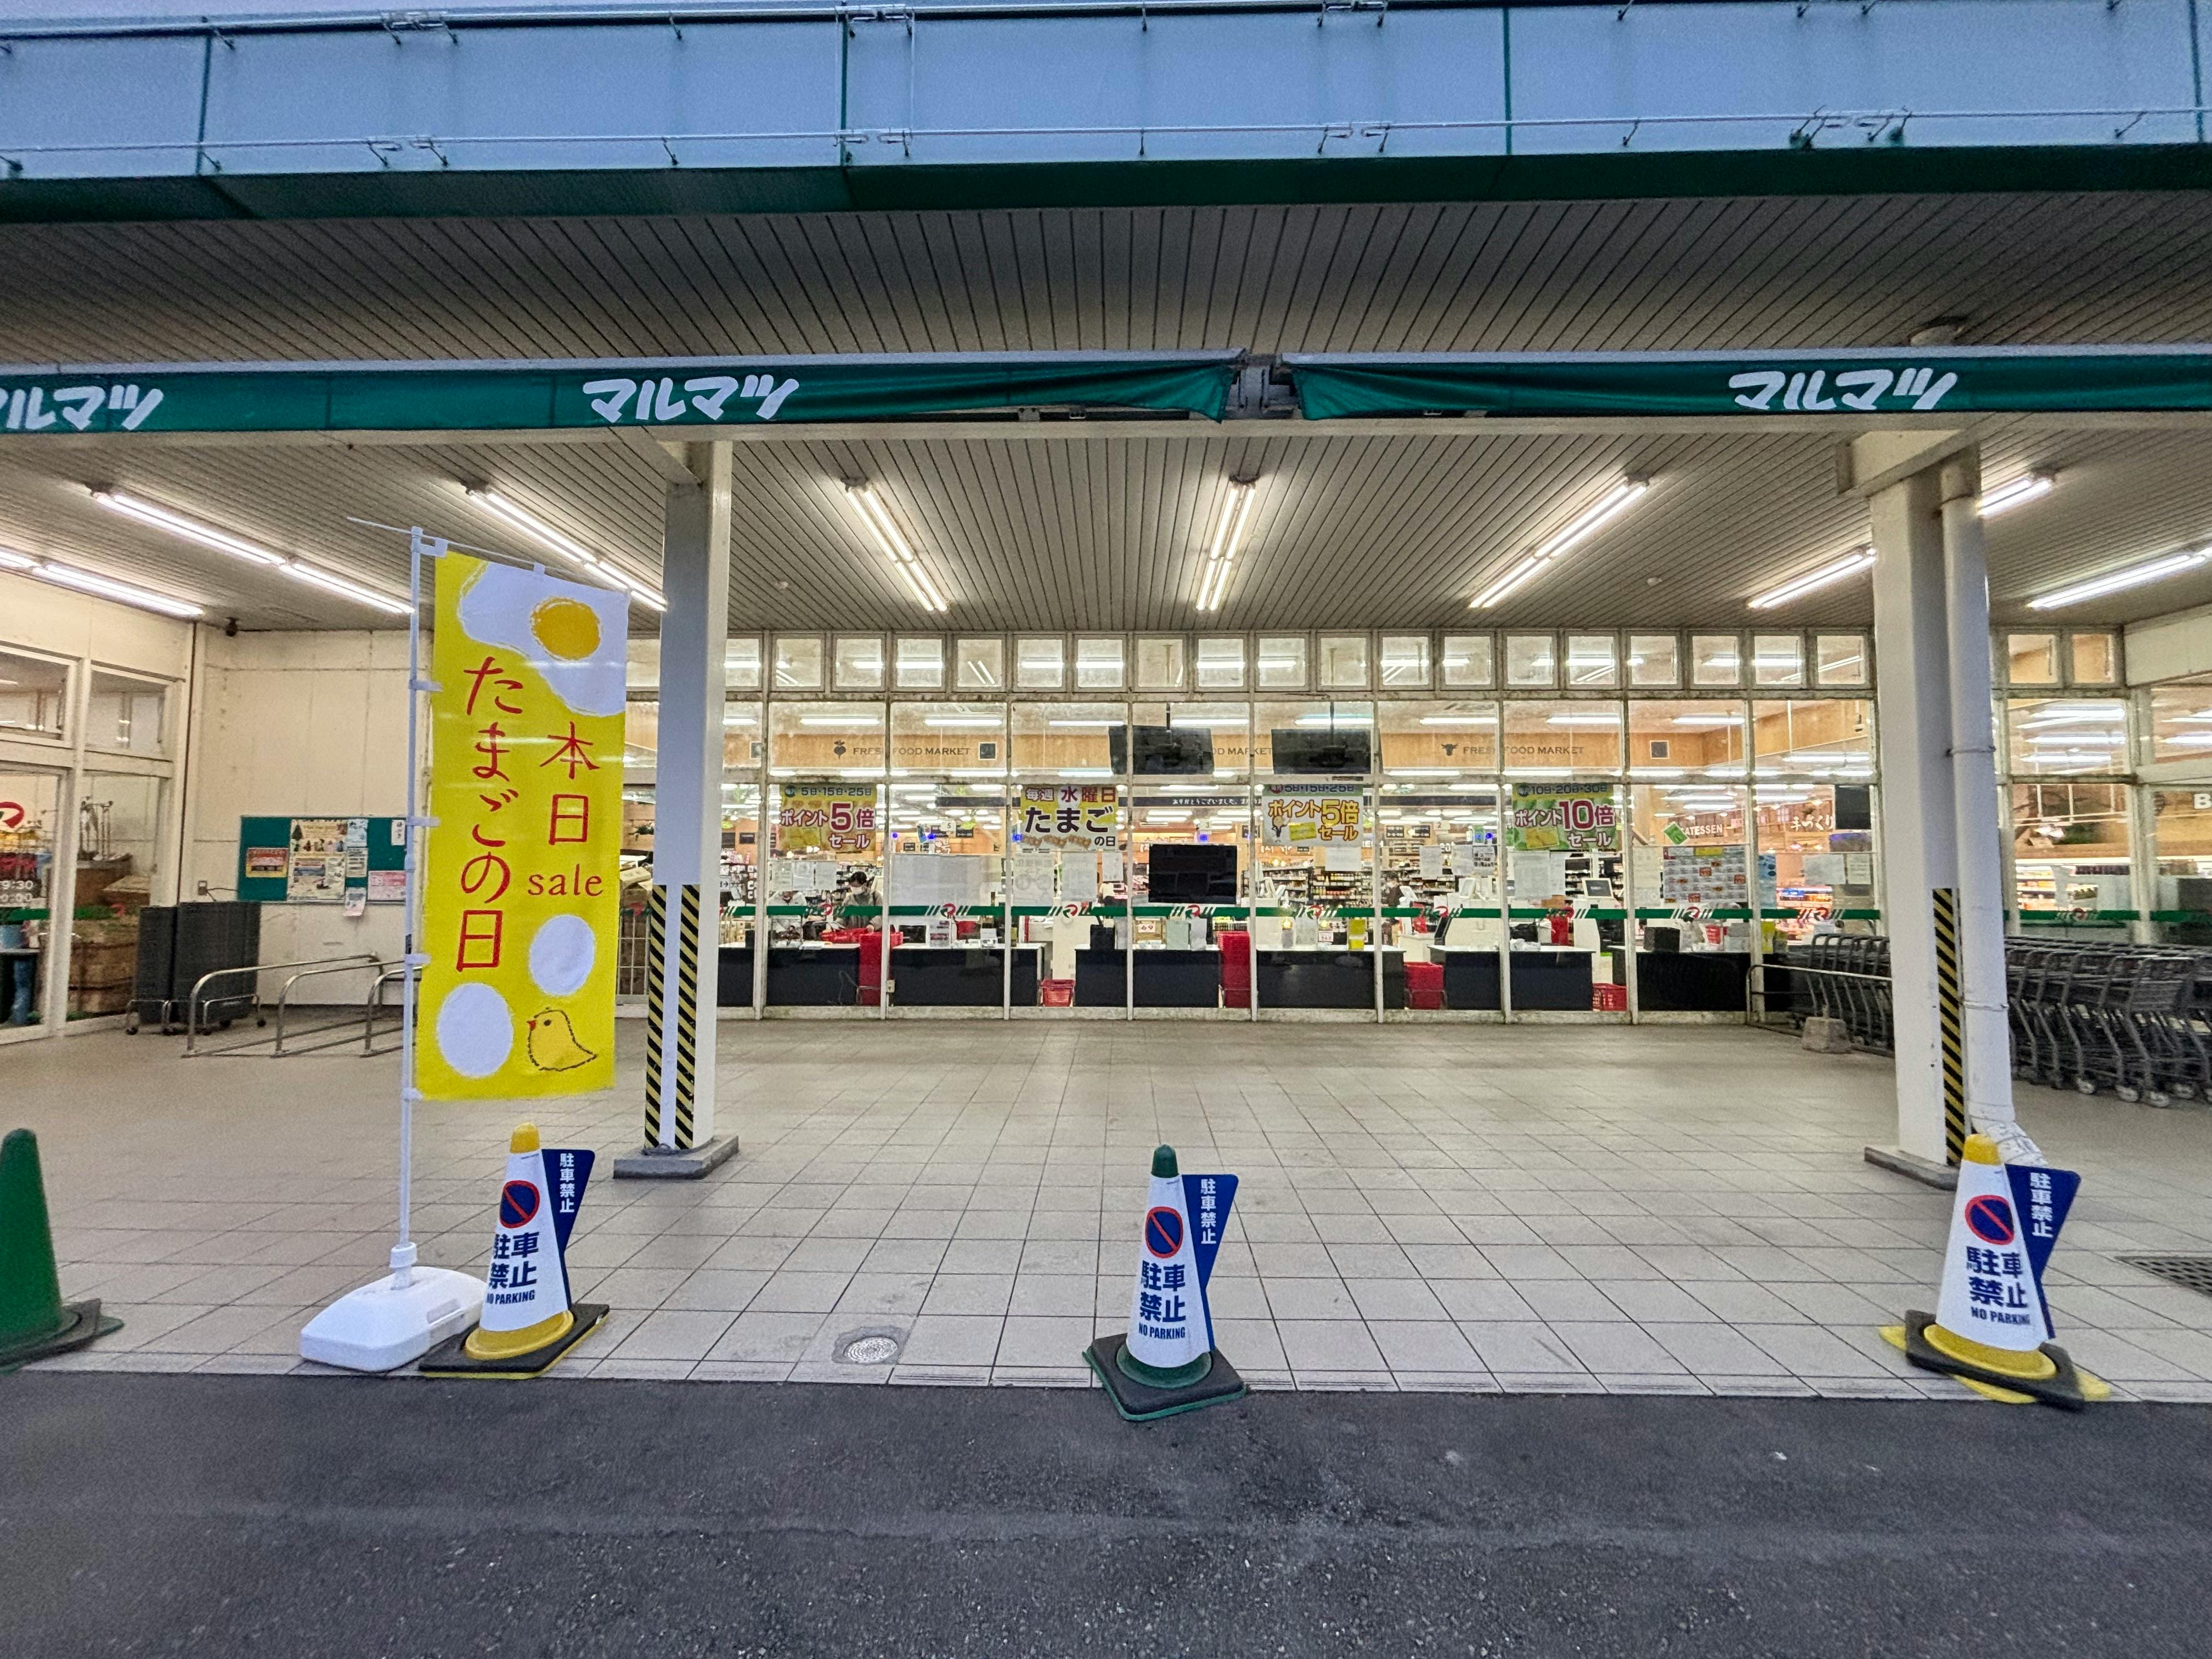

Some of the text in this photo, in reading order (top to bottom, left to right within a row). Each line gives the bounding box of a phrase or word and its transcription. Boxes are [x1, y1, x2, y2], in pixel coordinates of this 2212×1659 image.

[583, 374, 799, 423] マルマツ
[1729, 368, 1958, 410] マルマツ
[0, 385, 163, 430] ルマツ
[540, 721, 600, 845] 本日
[456, 656, 523, 972] たまごの日
[1025, 806, 1113, 833] たまご
[828, 833, 871, 849] セール
[1094, 836, 1115, 846] の日
[1318, 825, 1358, 841] セール
[1567, 831, 1612, 848] セール
[527, 864, 603, 896] sale
[560, 1153, 574, 1213] 駐車禁止
[1200, 1178, 1216, 1244] 駐車禁止
[2029, 1172, 2053, 1238] 駐車禁止
[493, 1232, 539, 1259] 駐車
[489, 1261, 537, 1289] 禁止
[1141, 1260, 1185, 1291] 駐車
[1966, 1246, 2023, 1278] 駐車
[495, 1290, 535, 1305] PARKING
[1139, 1291, 1186, 1323] 禁止
[1968, 1277, 2028, 1308] 禁止
[1971, 1307, 1987, 1320] NO
[1139, 1322, 1186, 1340] NO PARKING
